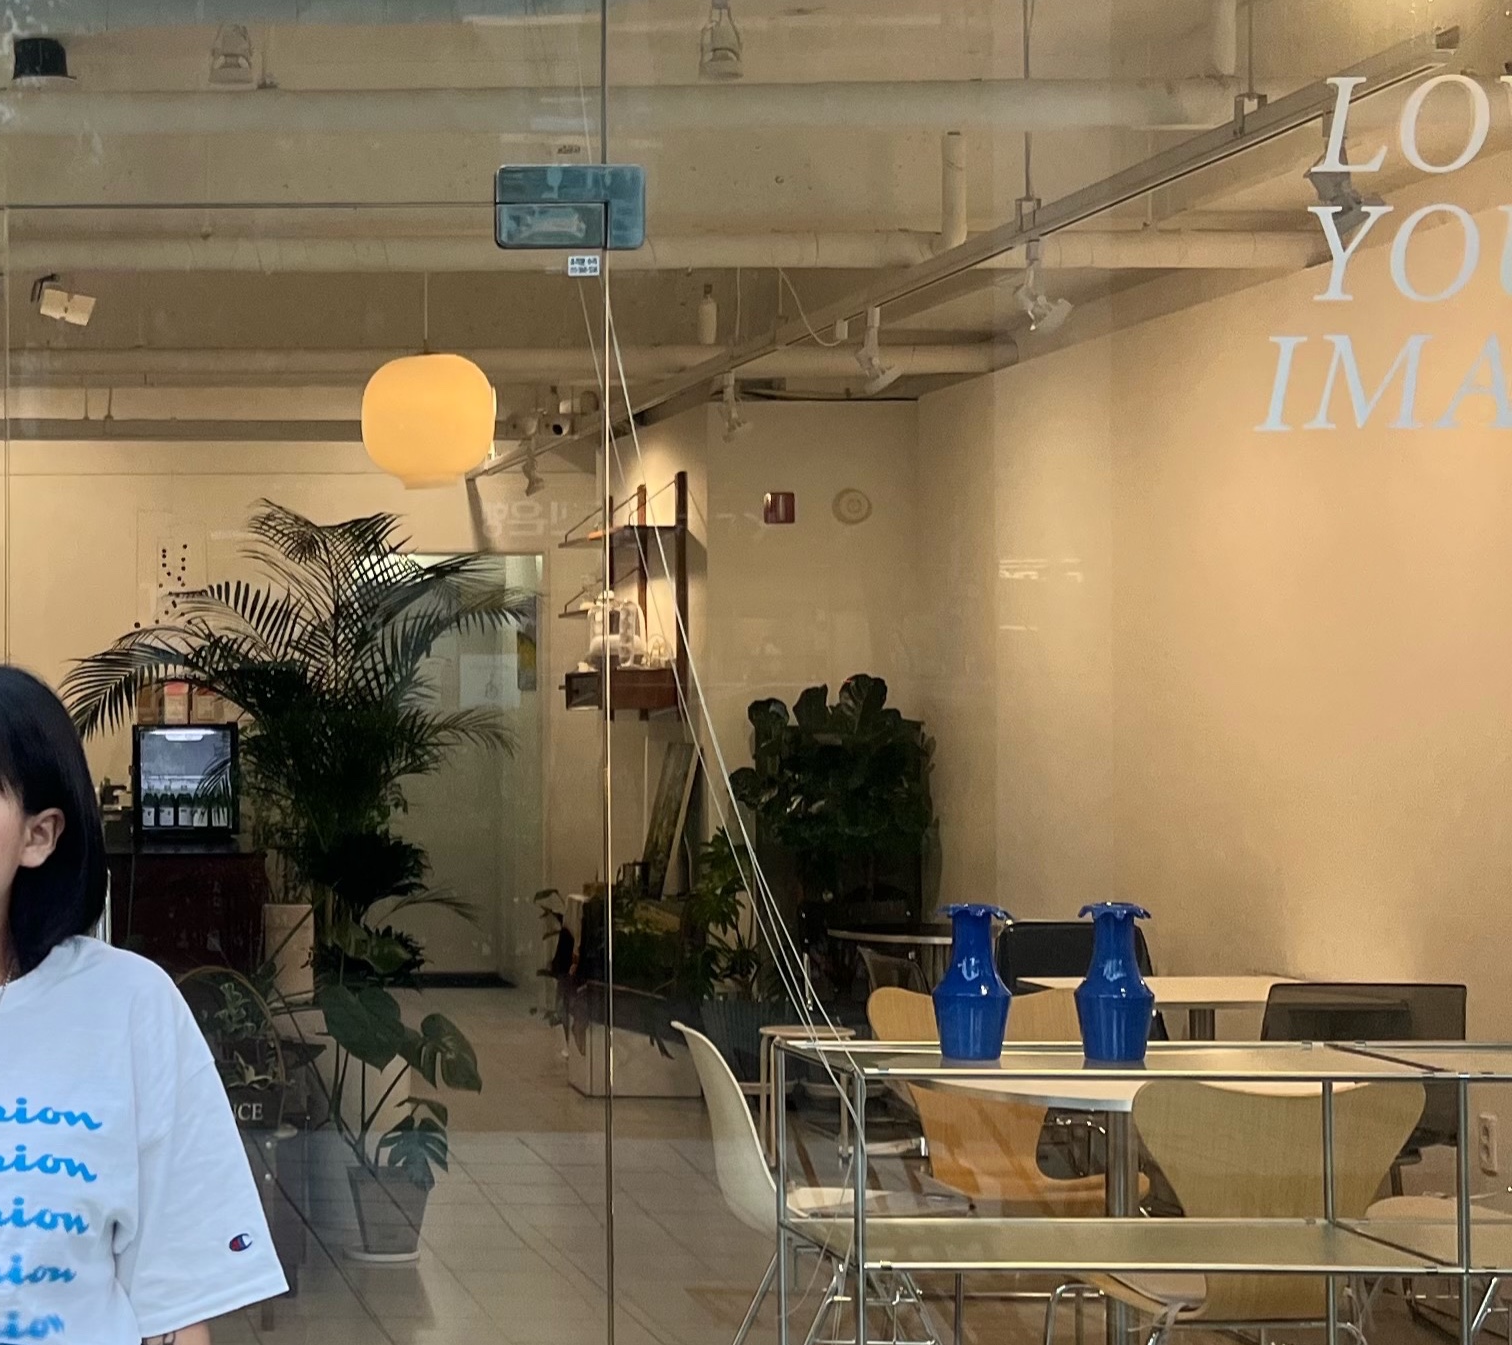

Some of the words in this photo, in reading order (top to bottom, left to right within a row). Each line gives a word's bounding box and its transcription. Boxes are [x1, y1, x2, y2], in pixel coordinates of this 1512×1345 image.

[1310, 74, 1512, 174] LO
[1308, 203, 1512, 303] YO
[233, 1103, 264, 1122] CE
